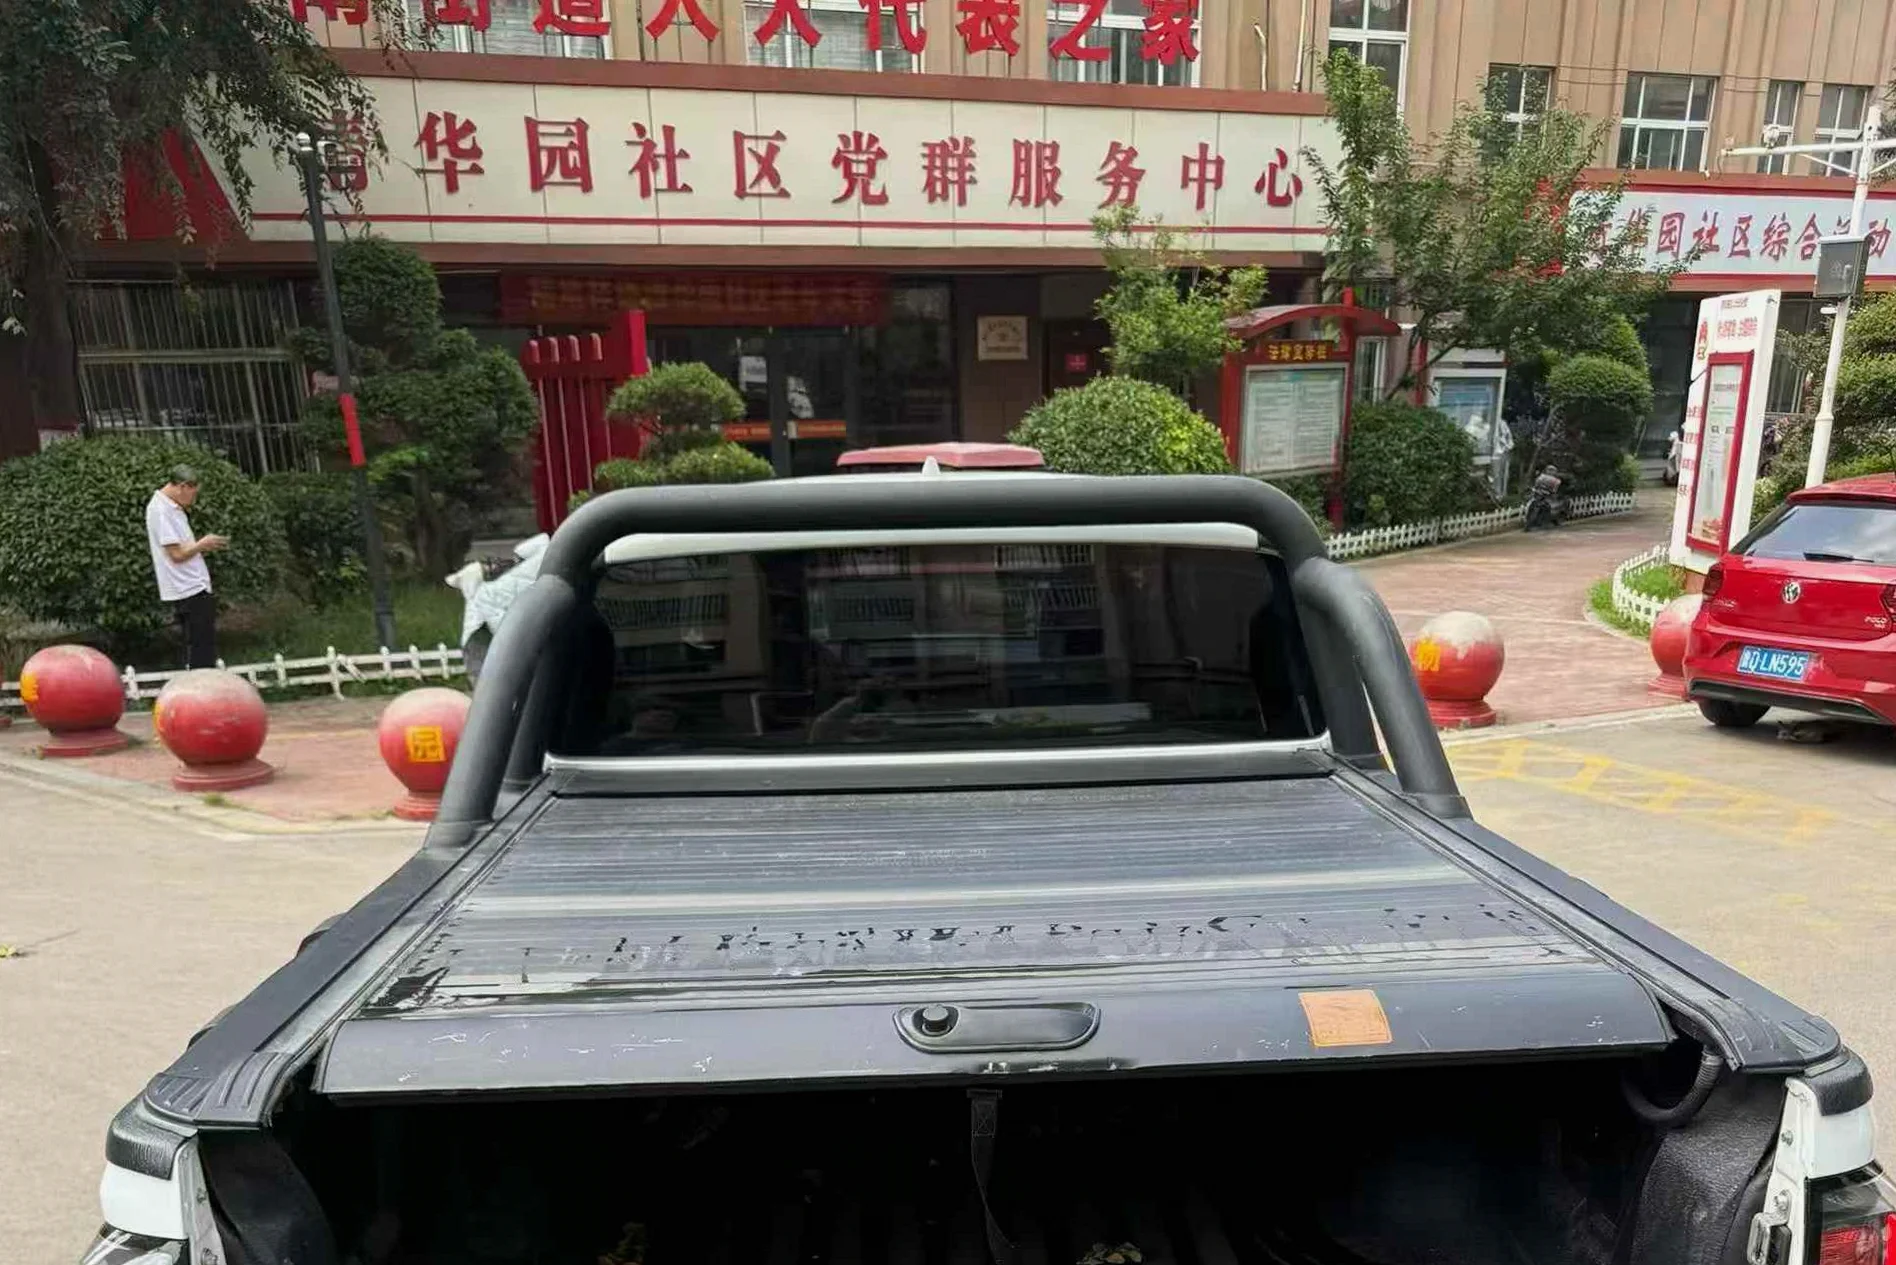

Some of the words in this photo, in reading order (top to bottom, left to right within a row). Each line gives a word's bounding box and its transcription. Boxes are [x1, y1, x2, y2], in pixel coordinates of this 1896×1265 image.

[1590, 208, 1892, 260] 华园社区综合动
